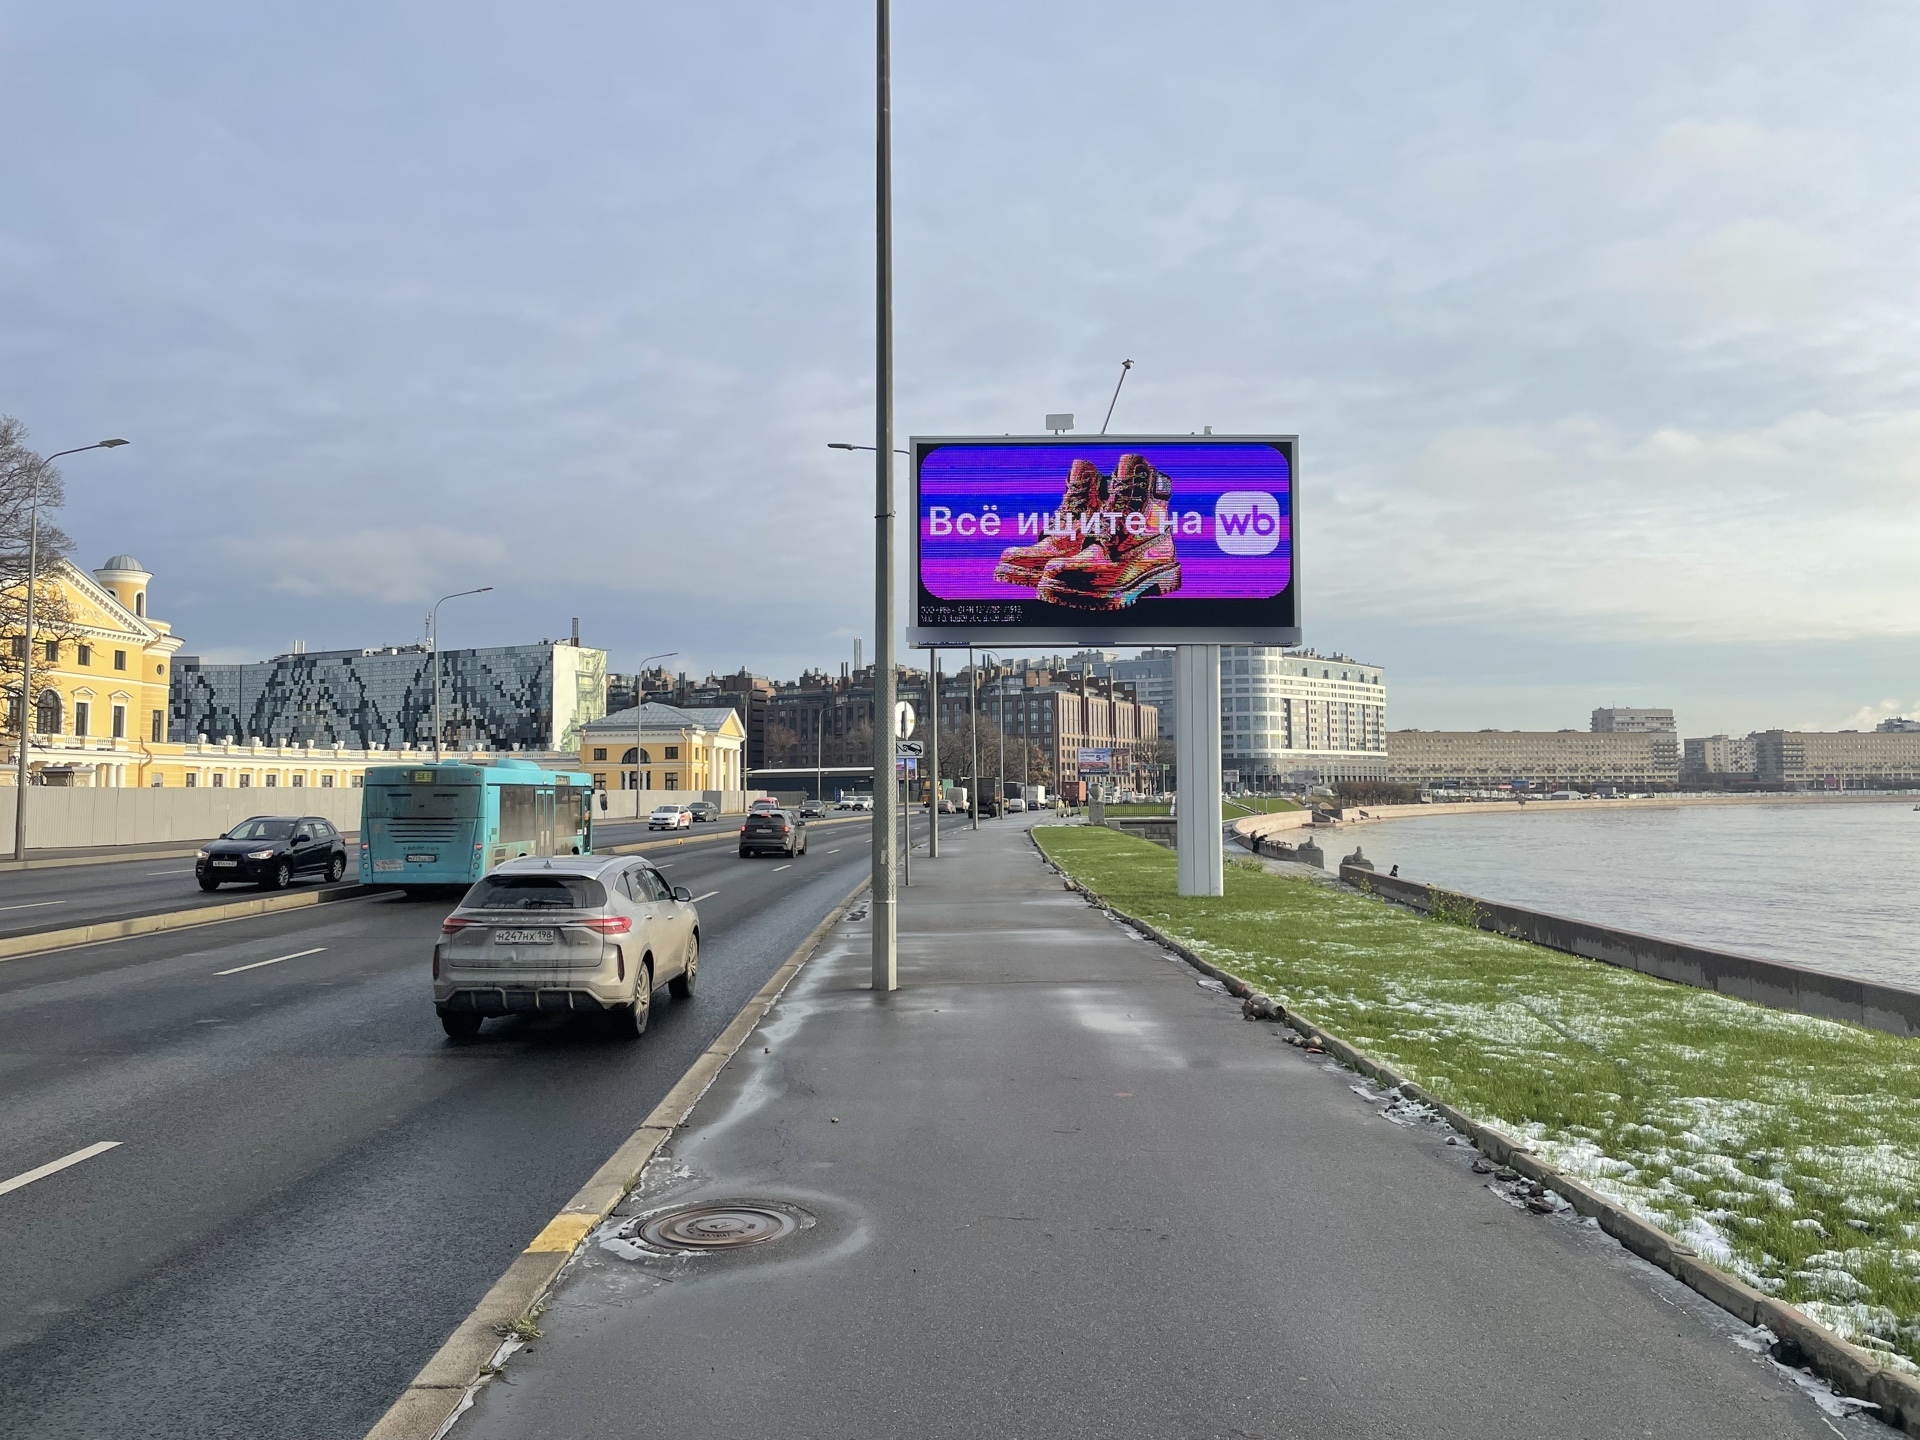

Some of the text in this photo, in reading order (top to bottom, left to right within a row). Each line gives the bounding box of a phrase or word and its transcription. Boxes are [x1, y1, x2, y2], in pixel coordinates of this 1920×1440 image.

[929, 505, 1276, 541] Всё ищите на wb
